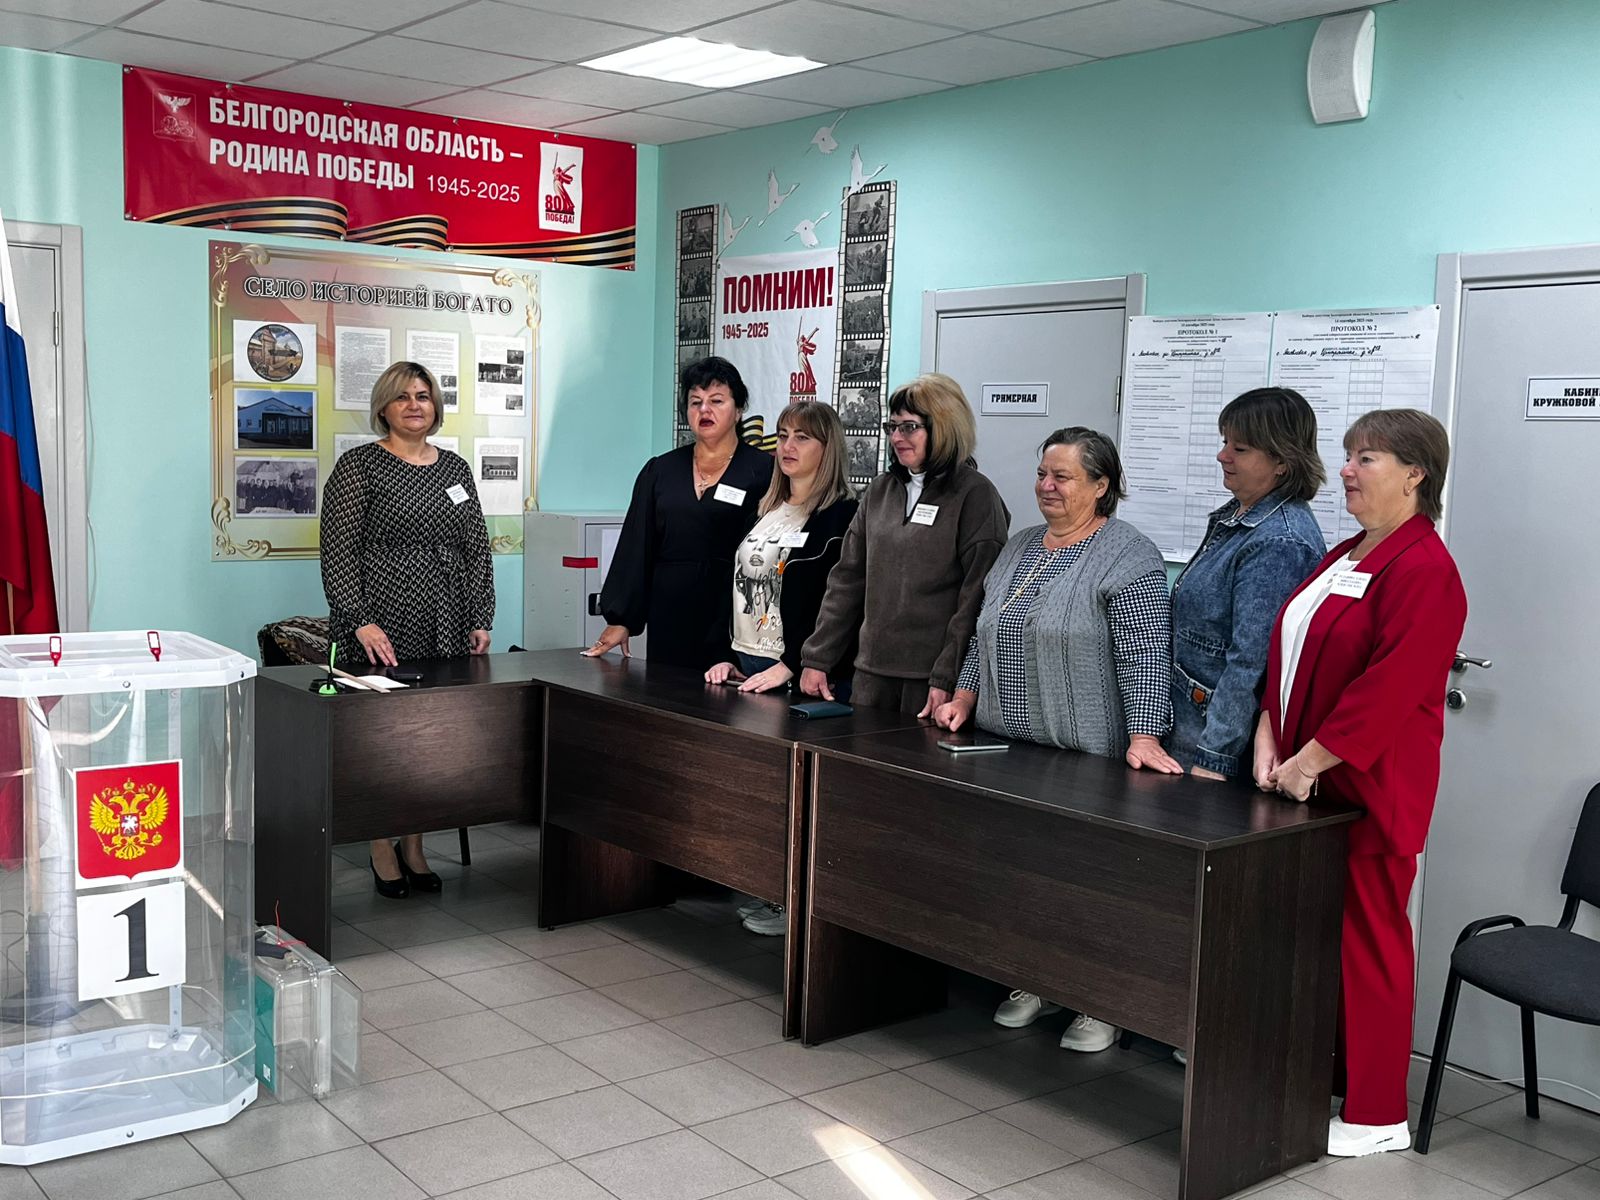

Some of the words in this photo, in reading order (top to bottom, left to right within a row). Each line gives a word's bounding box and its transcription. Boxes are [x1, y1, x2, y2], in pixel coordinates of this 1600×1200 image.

[208, 96, 399, 148] БЕЛГОРОДСКАЯ
[405, 126, 504, 164] ОБЛАСТЬ
[208, 137, 310, 178] РОДИНА
[316, 152, 415, 190] ПОБЕДЫ
[427, 174, 521, 204] 1945-2025
[545, 194, 563, 211] 80
[545, 212, 576, 224] ПОБЕДА!
[244, 276, 307, 299] СЕЛО
[311, 281, 431, 309] ИСТОРИЕЙ
[432, 292, 513, 315] БОГАТО
[722, 266, 834, 315] ПОМНИМ!
[790, 371, 805, 392] 80
[1563, 387, 1600, 397] КАБИН
[991, 393, 1037, 403] ГРИМЕРНАЯ
[1533, 397, 1596, 407] КРУЖКОВОЙ
[113, 897, 160, 983] 1
